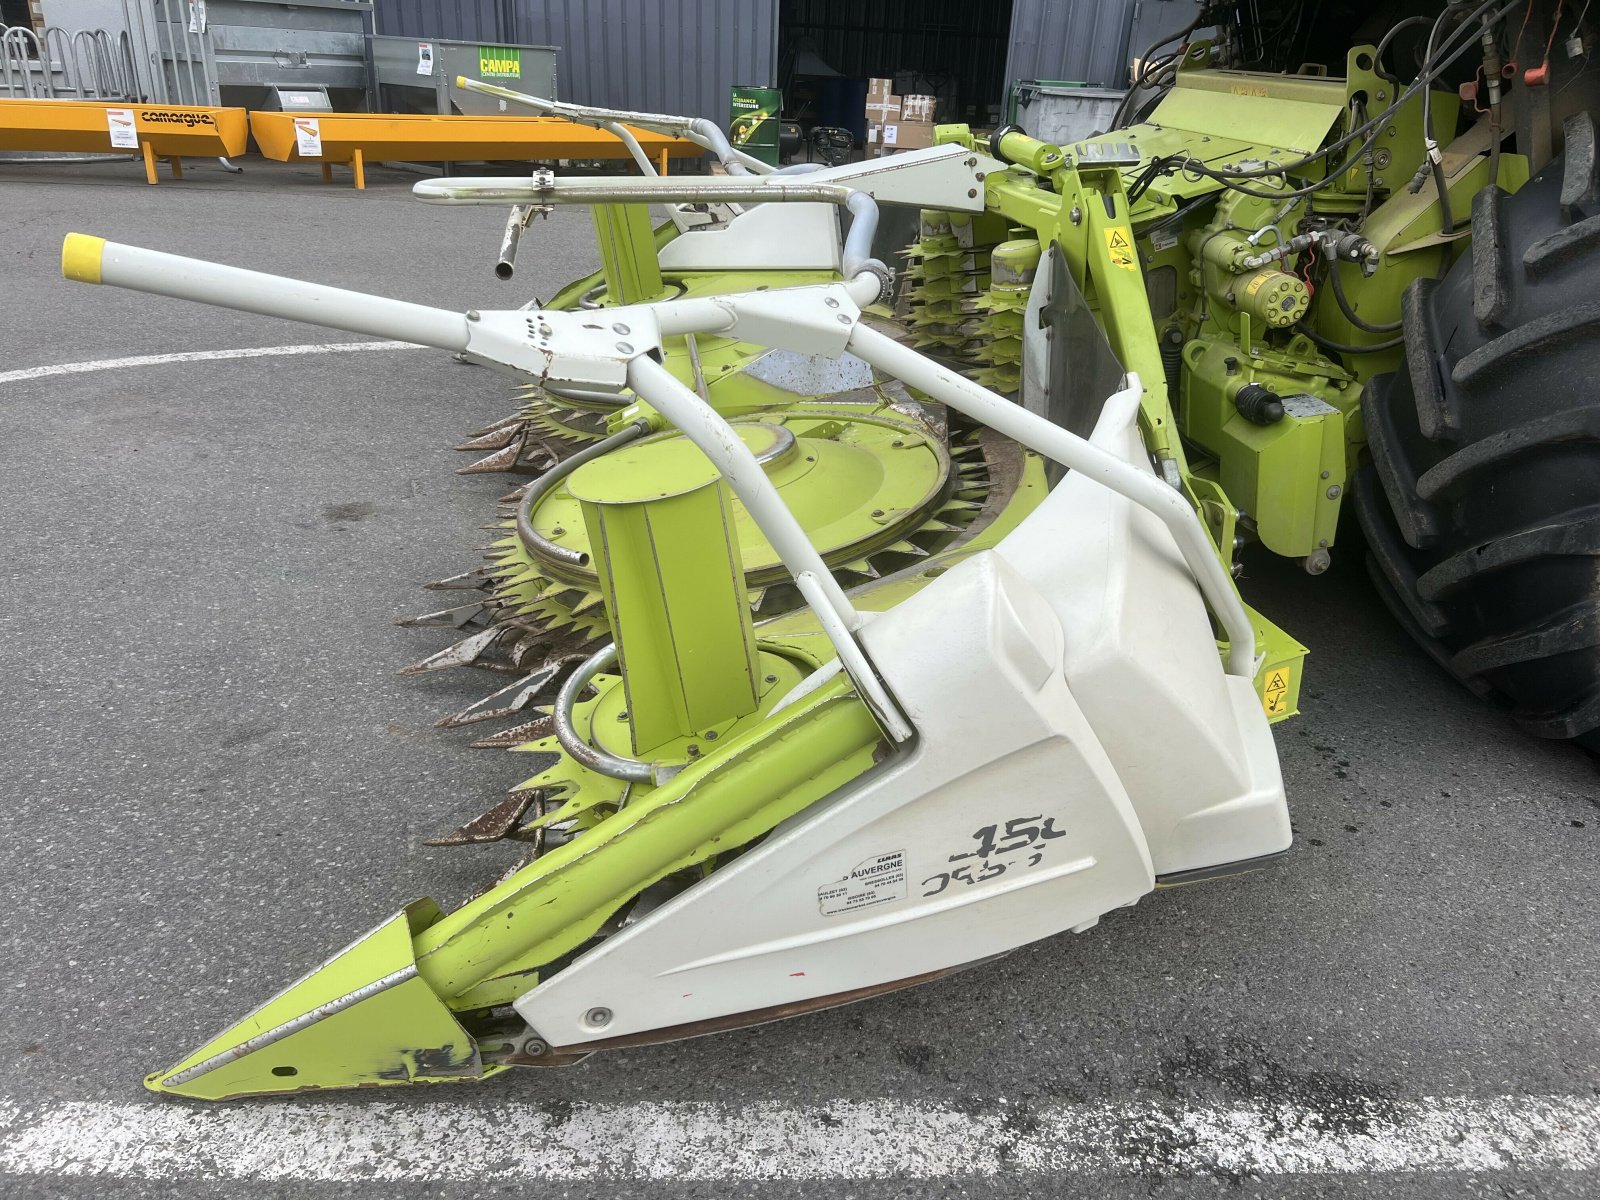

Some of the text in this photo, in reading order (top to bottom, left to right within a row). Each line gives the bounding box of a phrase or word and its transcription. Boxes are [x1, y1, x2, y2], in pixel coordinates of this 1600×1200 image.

[480, 58, 520, 73] CAMPA
[141, 111, 215, 128] camargue
[851, 859, 903, 879] AUVERGNE
